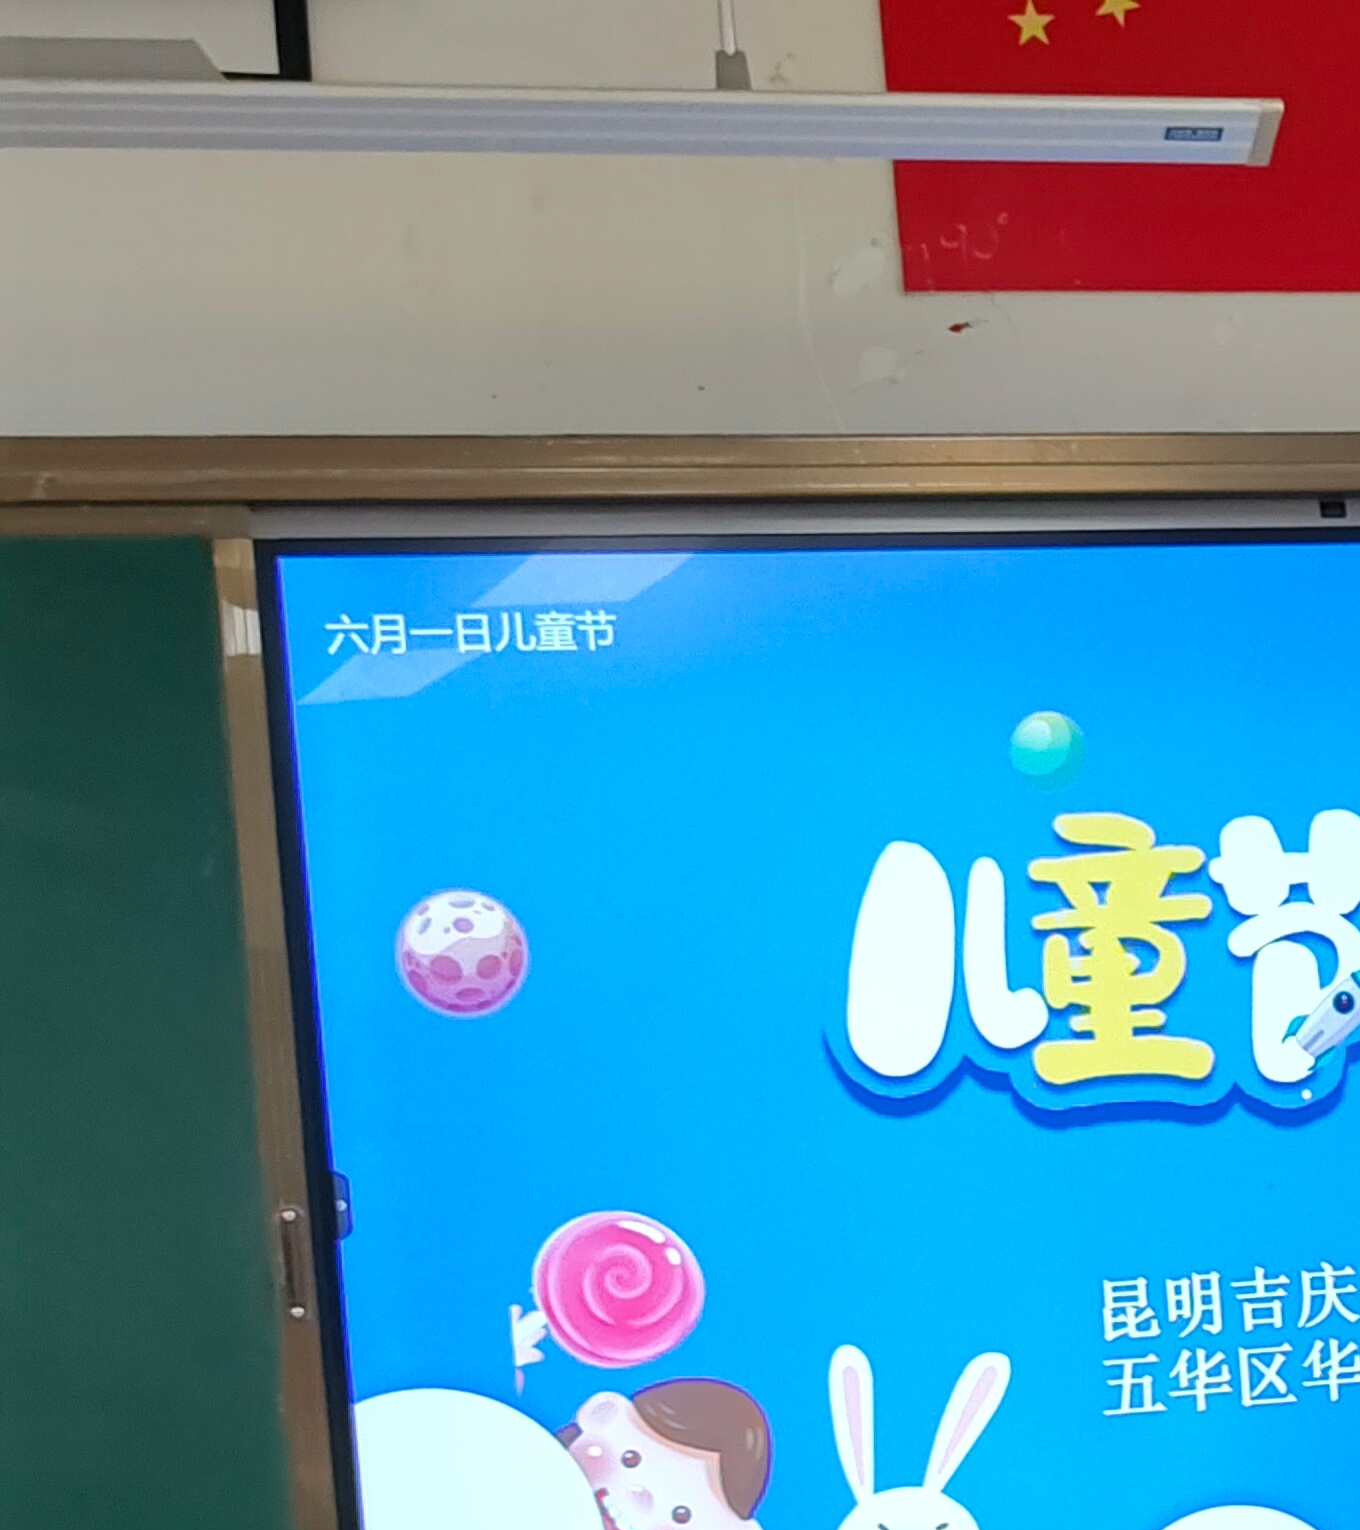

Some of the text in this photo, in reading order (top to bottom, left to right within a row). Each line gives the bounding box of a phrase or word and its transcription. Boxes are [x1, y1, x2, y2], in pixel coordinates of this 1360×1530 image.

[325, 611, 616, 654] 六月一日儿童节
